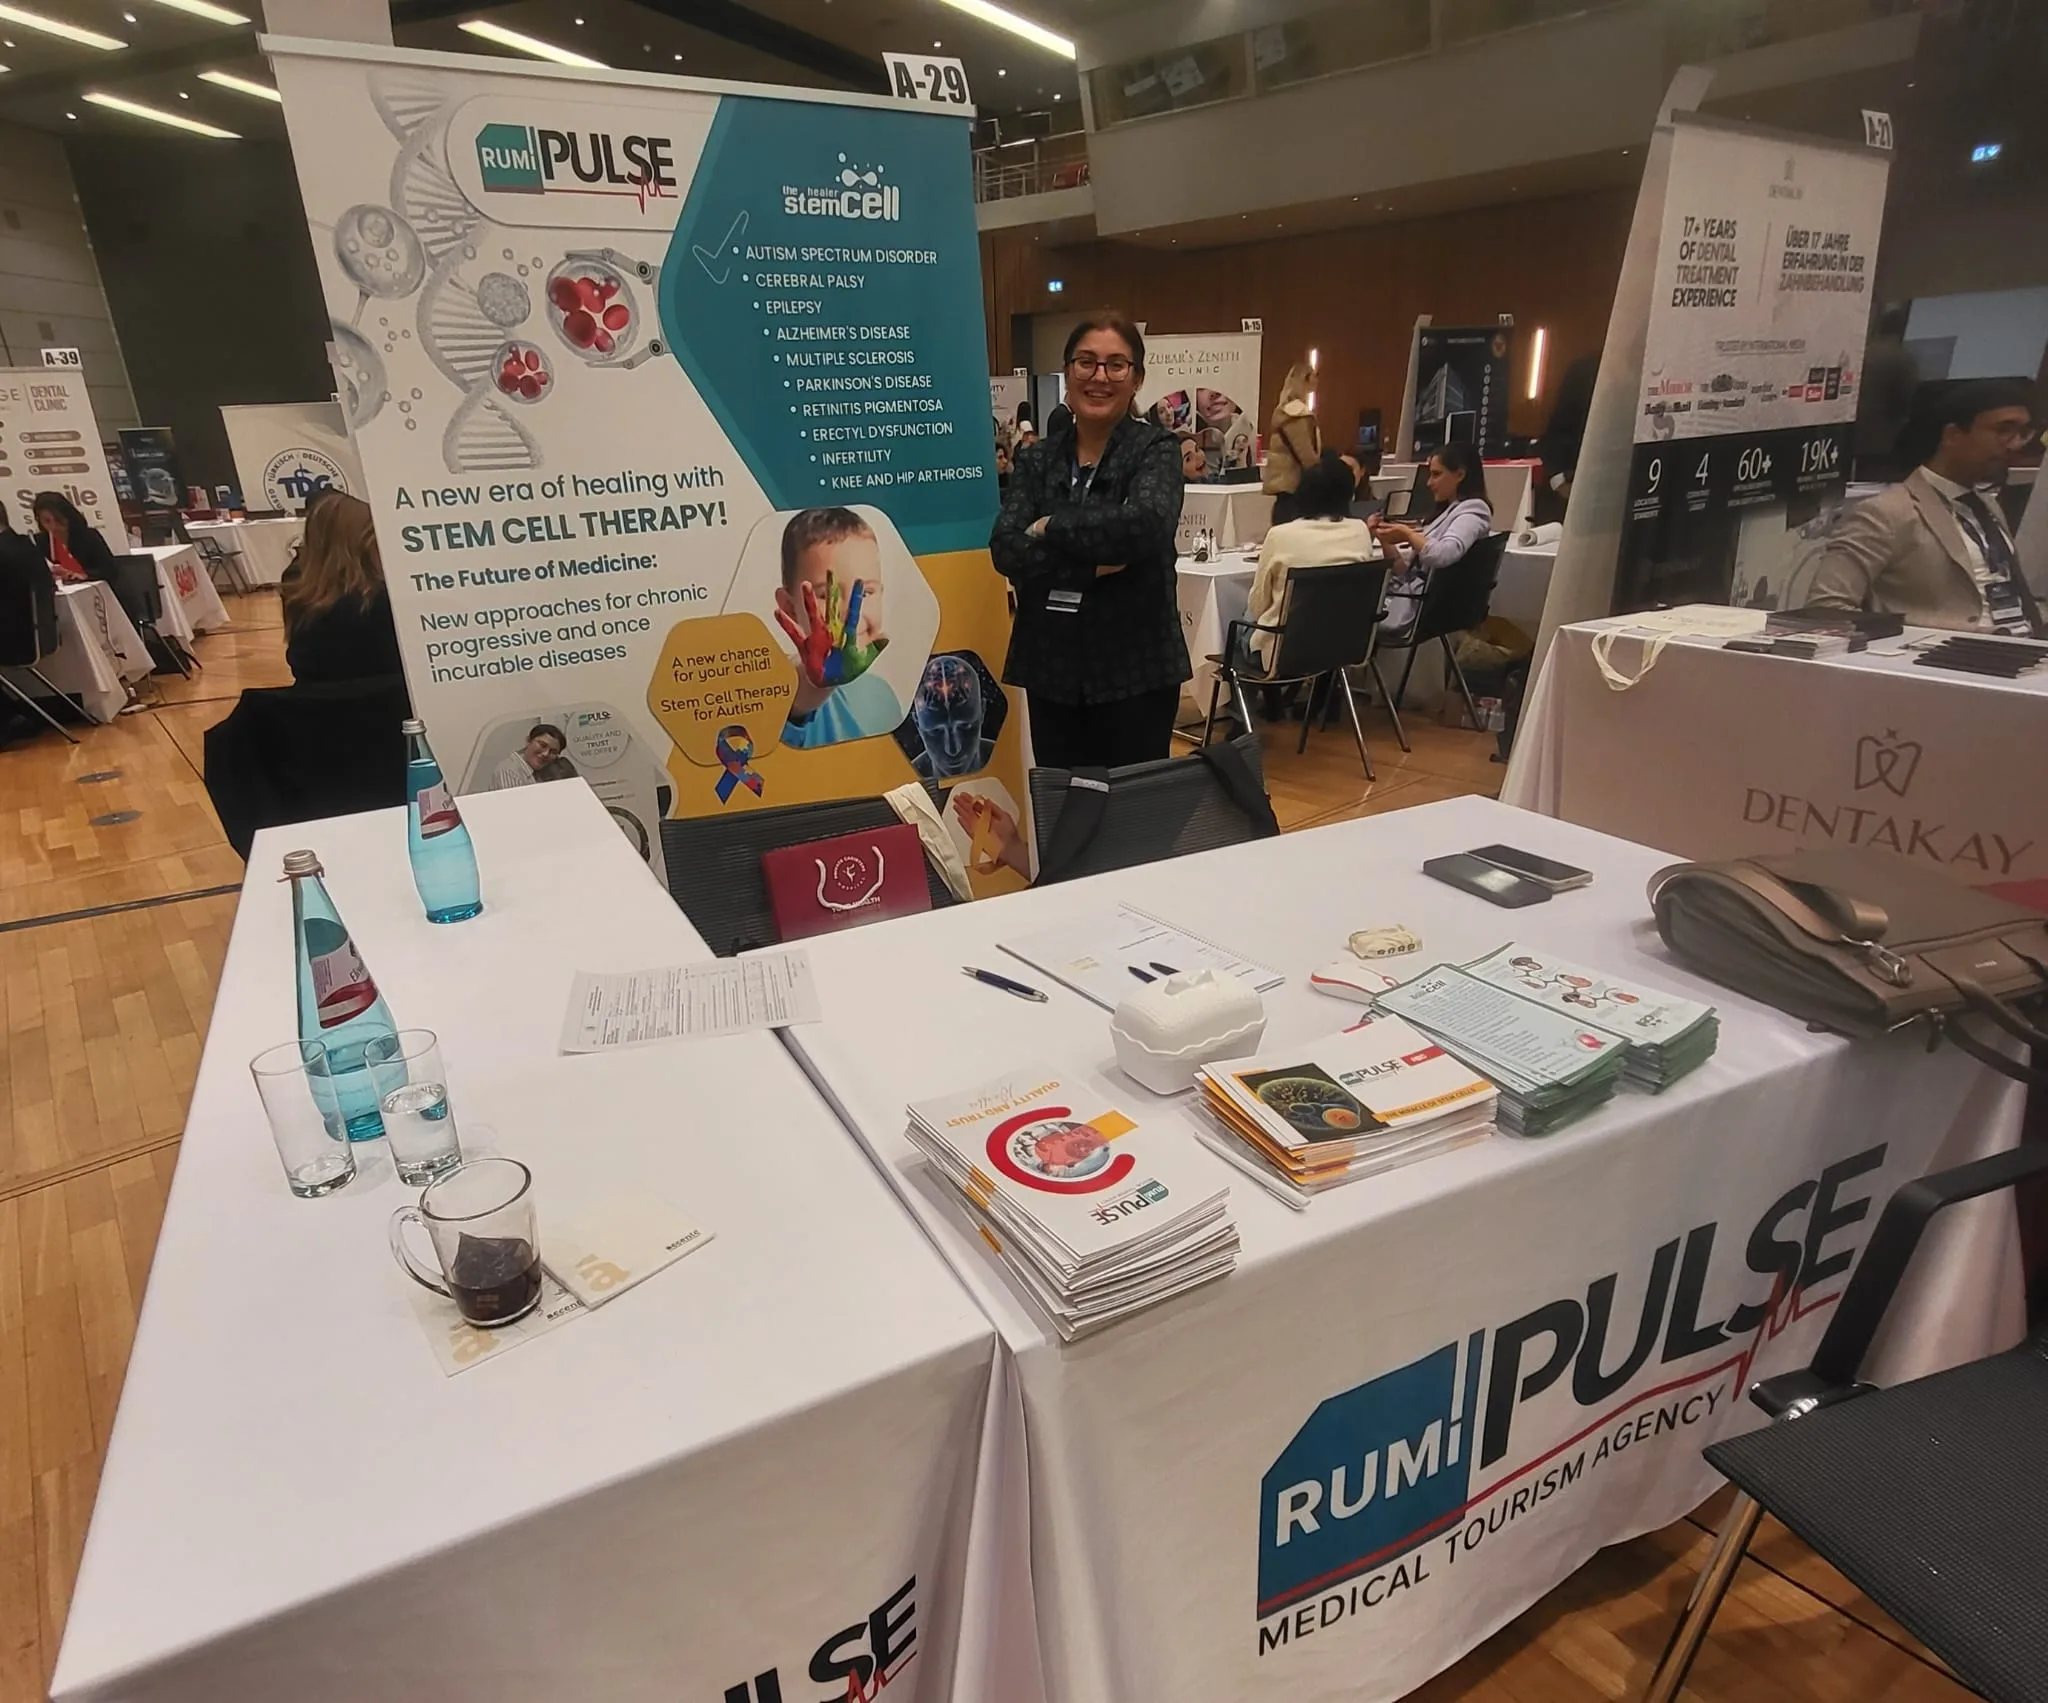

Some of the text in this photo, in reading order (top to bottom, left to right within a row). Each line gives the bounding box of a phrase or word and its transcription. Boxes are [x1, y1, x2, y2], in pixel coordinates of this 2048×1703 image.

[893, 61, 967, 105] A-29
[538, 129, 677, 187] PULSE
[783, 185, 838, 198] the healer
[1683, 216, 1737, 239] 17+ YEARS
[1679, 241, 1737, 262] OF DENTAL
[1810, 232, 1821, 248] 17
[1822, 233, 1850, 251] JAHRE
[746, 245, 938, 265] AUTISM SPECTRUM DISORDER
[1782, 252, 1865, 273] ERFAHRUNG IN DER
[755, 274, 866, 289] CEREBRAL PALSY
[1676, 265, 1740, 285] TREATMENT
[766, 300, 822, 314] EPILEPSY
[1671, 288, 1737, 308] EXPERIENCE
[776, 325, 910, 341] ALZHEIMER'S DISEASE
[1244, 321, 1261, 332] A-15
[45, 351, 79, 366] A-39
[786, 350, 915, 367] MULTIPLE SCLEROSIS
[1198, 350, 1240, 363] ZENITH
[1167, 366, 1221, 376] CLINIC
[30, 385, 69, 399] DENTAL
[797, 375, 932, 392] PARKINSON'S DISEASE
[35, 398, 68, 411] CLINIC
[803, 399, 943, 417] RETINITIS PIGMENTOSA
[813, 422, 953, 442] ERECTYL DYSFUNCTION
[302, 452, 339, 478] DEUTSCHE
[822, 449, 892, 465] INFERTILITY
[1737, 447, 1772, 482] 60+
[1801, 438, 1839, 473] 19K+
[832, 466, 983, 489] KNEE AND HIP ARTHROSIS
[1647, 458, 1662, 494] 9
[1695, 453, 1710, 486] 4
[16, 484, 98, 508] Sile
[394, 466, 724, 510] A new era of healing with
[401, 501, 728, 553] STEM CELL THERAPY!
[410, 552, 658, 592] The Future of Medicine:
[420, 582, 709, 633] New approaches for chronic
[425, 615, 651, 663] progressive and once
[431, 644, 627, 684] incurable diseases
[671, 646, 770, 669] A new chance
[673, 659, 772, 684] for your child!
[660, 683, 790, 714] Stem Cell Therapy
[694, 700, 764, 721] for Autism
[586, 739, 609, 749] TRUST
[603, 729, 622, 739] AND
[1742, 787, 2035, 874] DENTAKAY
[1013, 1081, 1060, 1107] QUALITY
[985, 1102, 1010, 1116] AND
[945, 1113, 984, 1128] TRUST
[1090, 1194, 1150, 1226] PULSE
[1479, 1142, 1888, 1471] PULSE
[1258, 1382, 1725, 1657] MEDICAL TOURISM AGENCY
